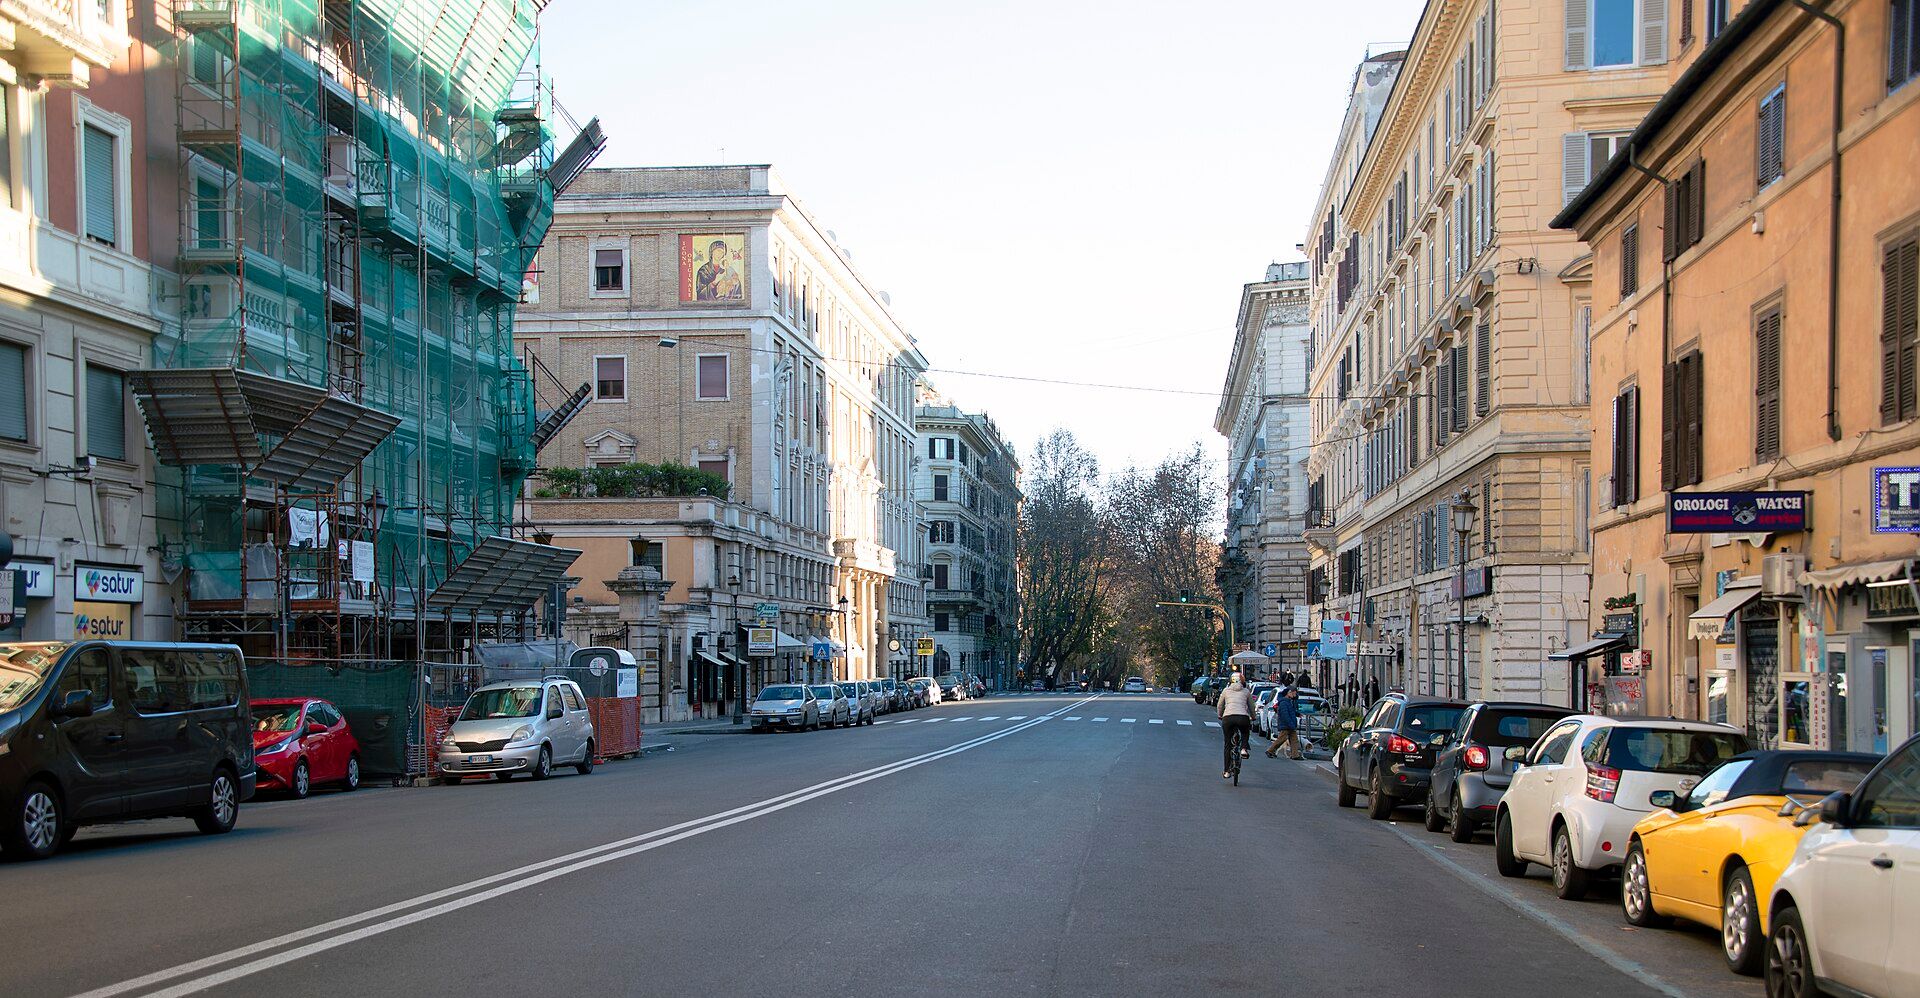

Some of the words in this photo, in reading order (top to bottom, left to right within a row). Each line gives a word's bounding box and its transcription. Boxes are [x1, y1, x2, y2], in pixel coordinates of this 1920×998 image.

[1674, 499, 1729, 511] OROLOGI
[1755, 497, 1802, 510] WATCH
[102, 572, 135, 594] satur
[757, 603, 778, 612] Pizza
[91, 615, 124, 636] satur
